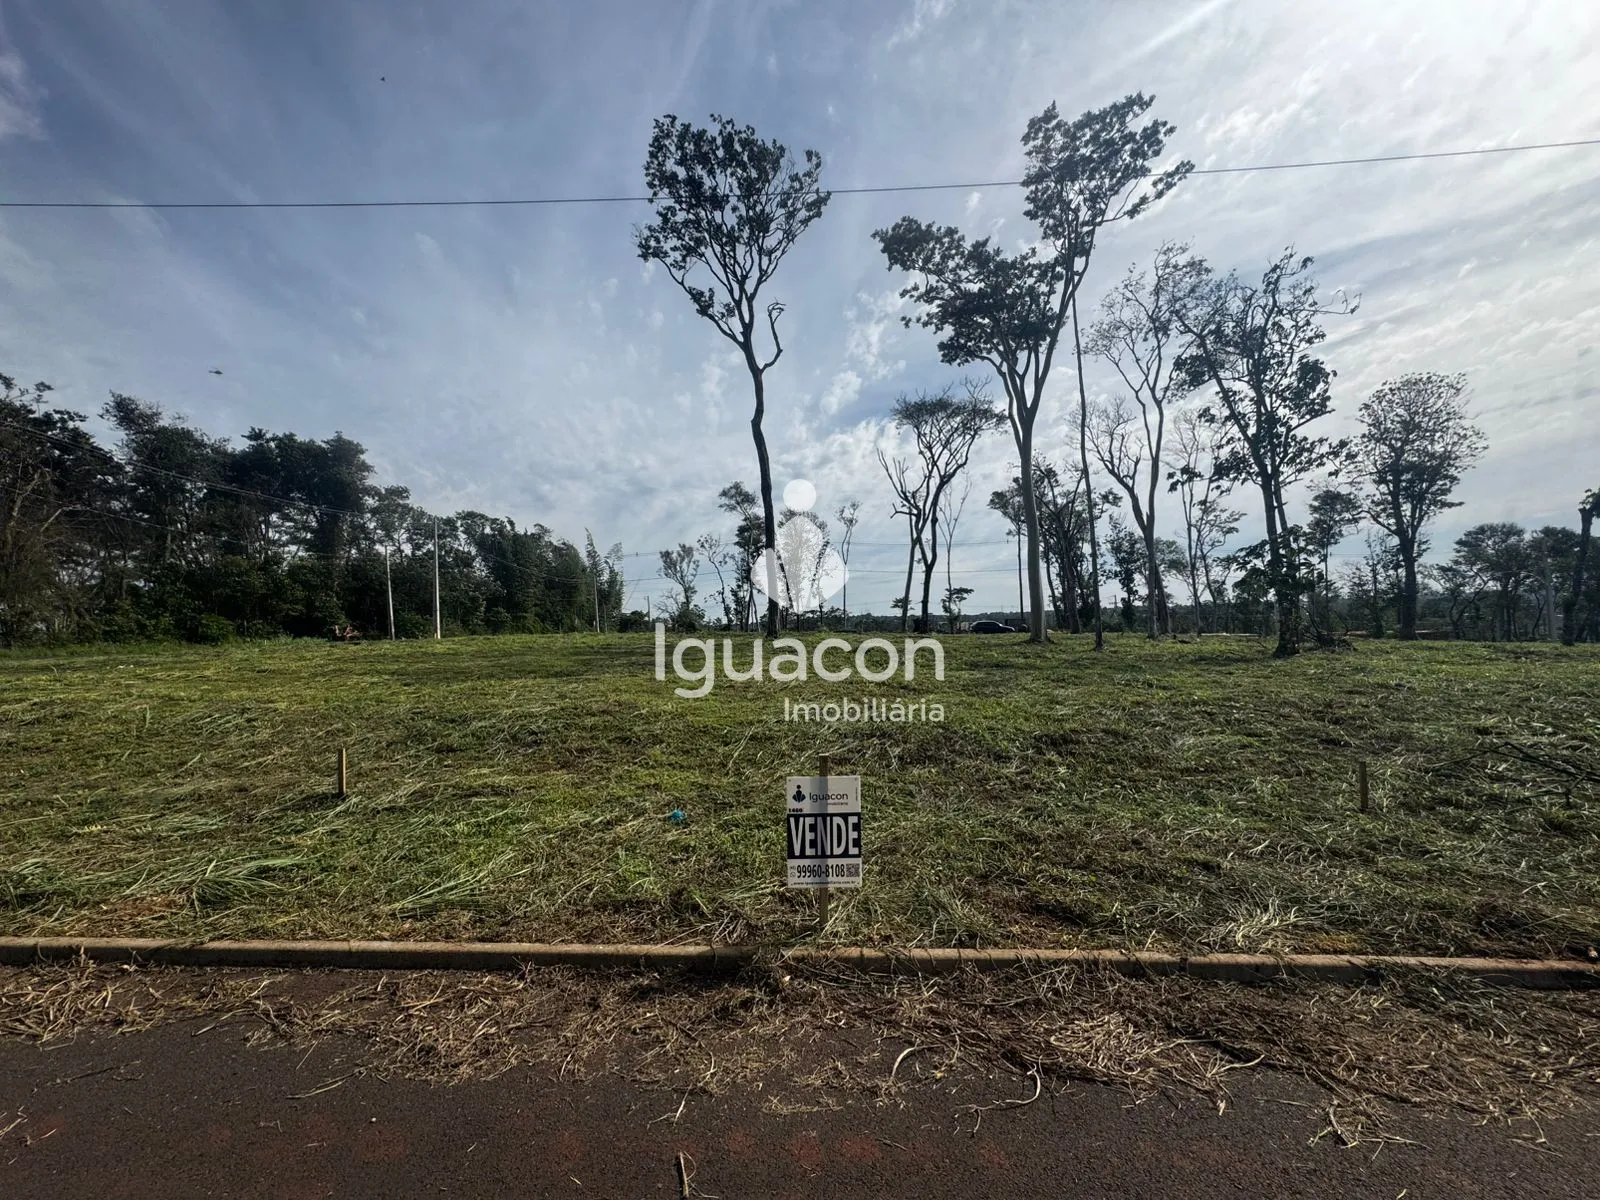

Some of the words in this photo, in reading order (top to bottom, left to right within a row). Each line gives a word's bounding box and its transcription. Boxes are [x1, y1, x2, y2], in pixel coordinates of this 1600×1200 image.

[809, 792, 849, 803] Iguacon
[789, 815, 860, 856] VENDE
[796, 863, 846, 879] 99960-8108
